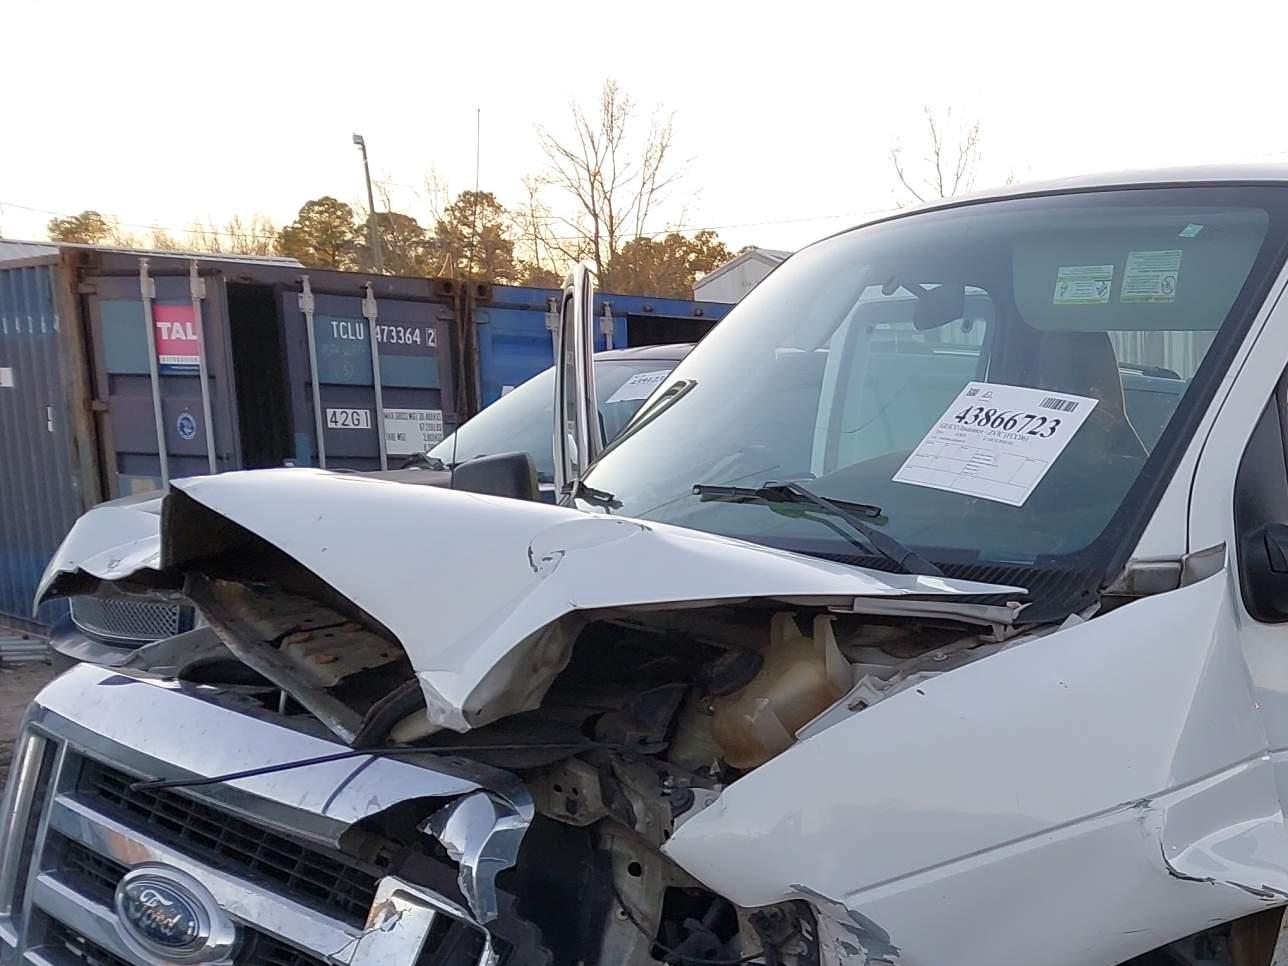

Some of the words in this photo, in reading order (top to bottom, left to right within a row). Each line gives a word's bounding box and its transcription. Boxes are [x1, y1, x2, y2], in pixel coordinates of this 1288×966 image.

[156, 321, 198, 340] TAL
[331, 321, 365, 340] TCLU
[427, 329, 436, 347] 2
[330, 410, 369, 428] 42G1
[955, 405, 1061, 438] 43866723
[138, 888, 182, 932] Ford
